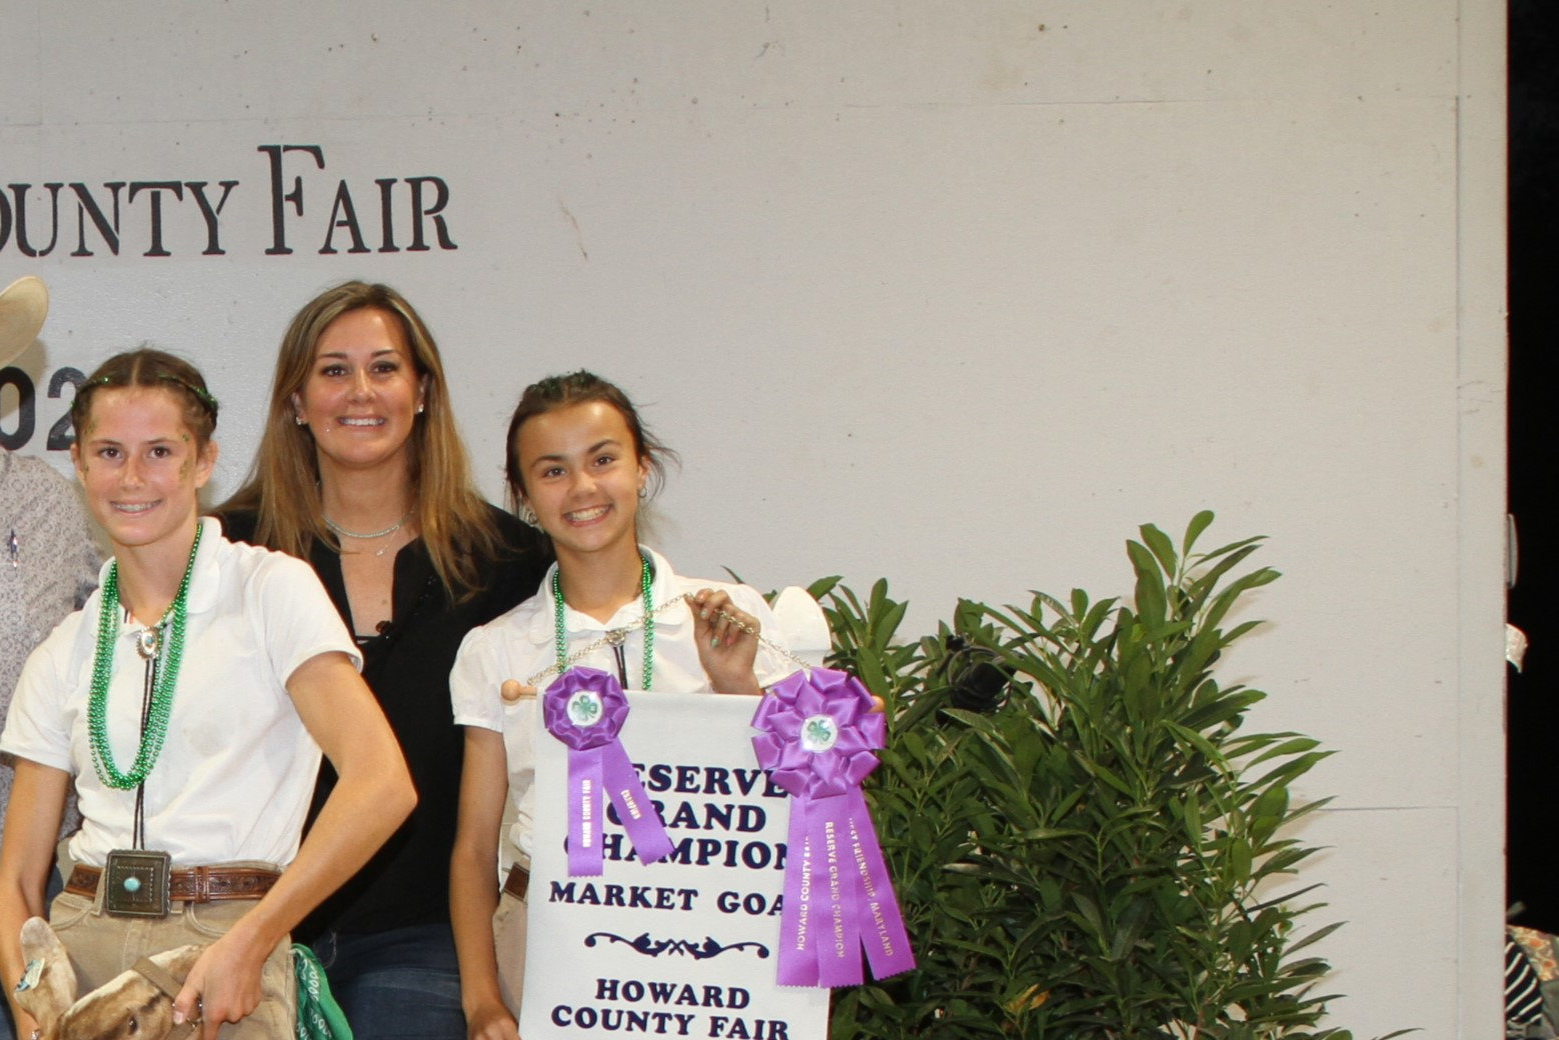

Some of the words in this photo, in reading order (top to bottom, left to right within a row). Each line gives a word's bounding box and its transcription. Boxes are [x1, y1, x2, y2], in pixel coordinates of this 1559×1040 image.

[257, 144, 458, 257] FAIR
[825, 821, 837, 863] RESERVE
[549, 881, 699, 911] MARKET
[717, 891, 783, 916] GOA
[801, 860, 812, 901] COUNTY
[829, 865, 840, 901] GRAND
[797, 905, 809, 950] HOWARD
[832, 903, 845, 958] CHAMPION
[870, 902, 893, 957] MARYLAND
[595, 979, 750, 1010] HOWARD
[551, 1005, 695, 1036] COUNTY
